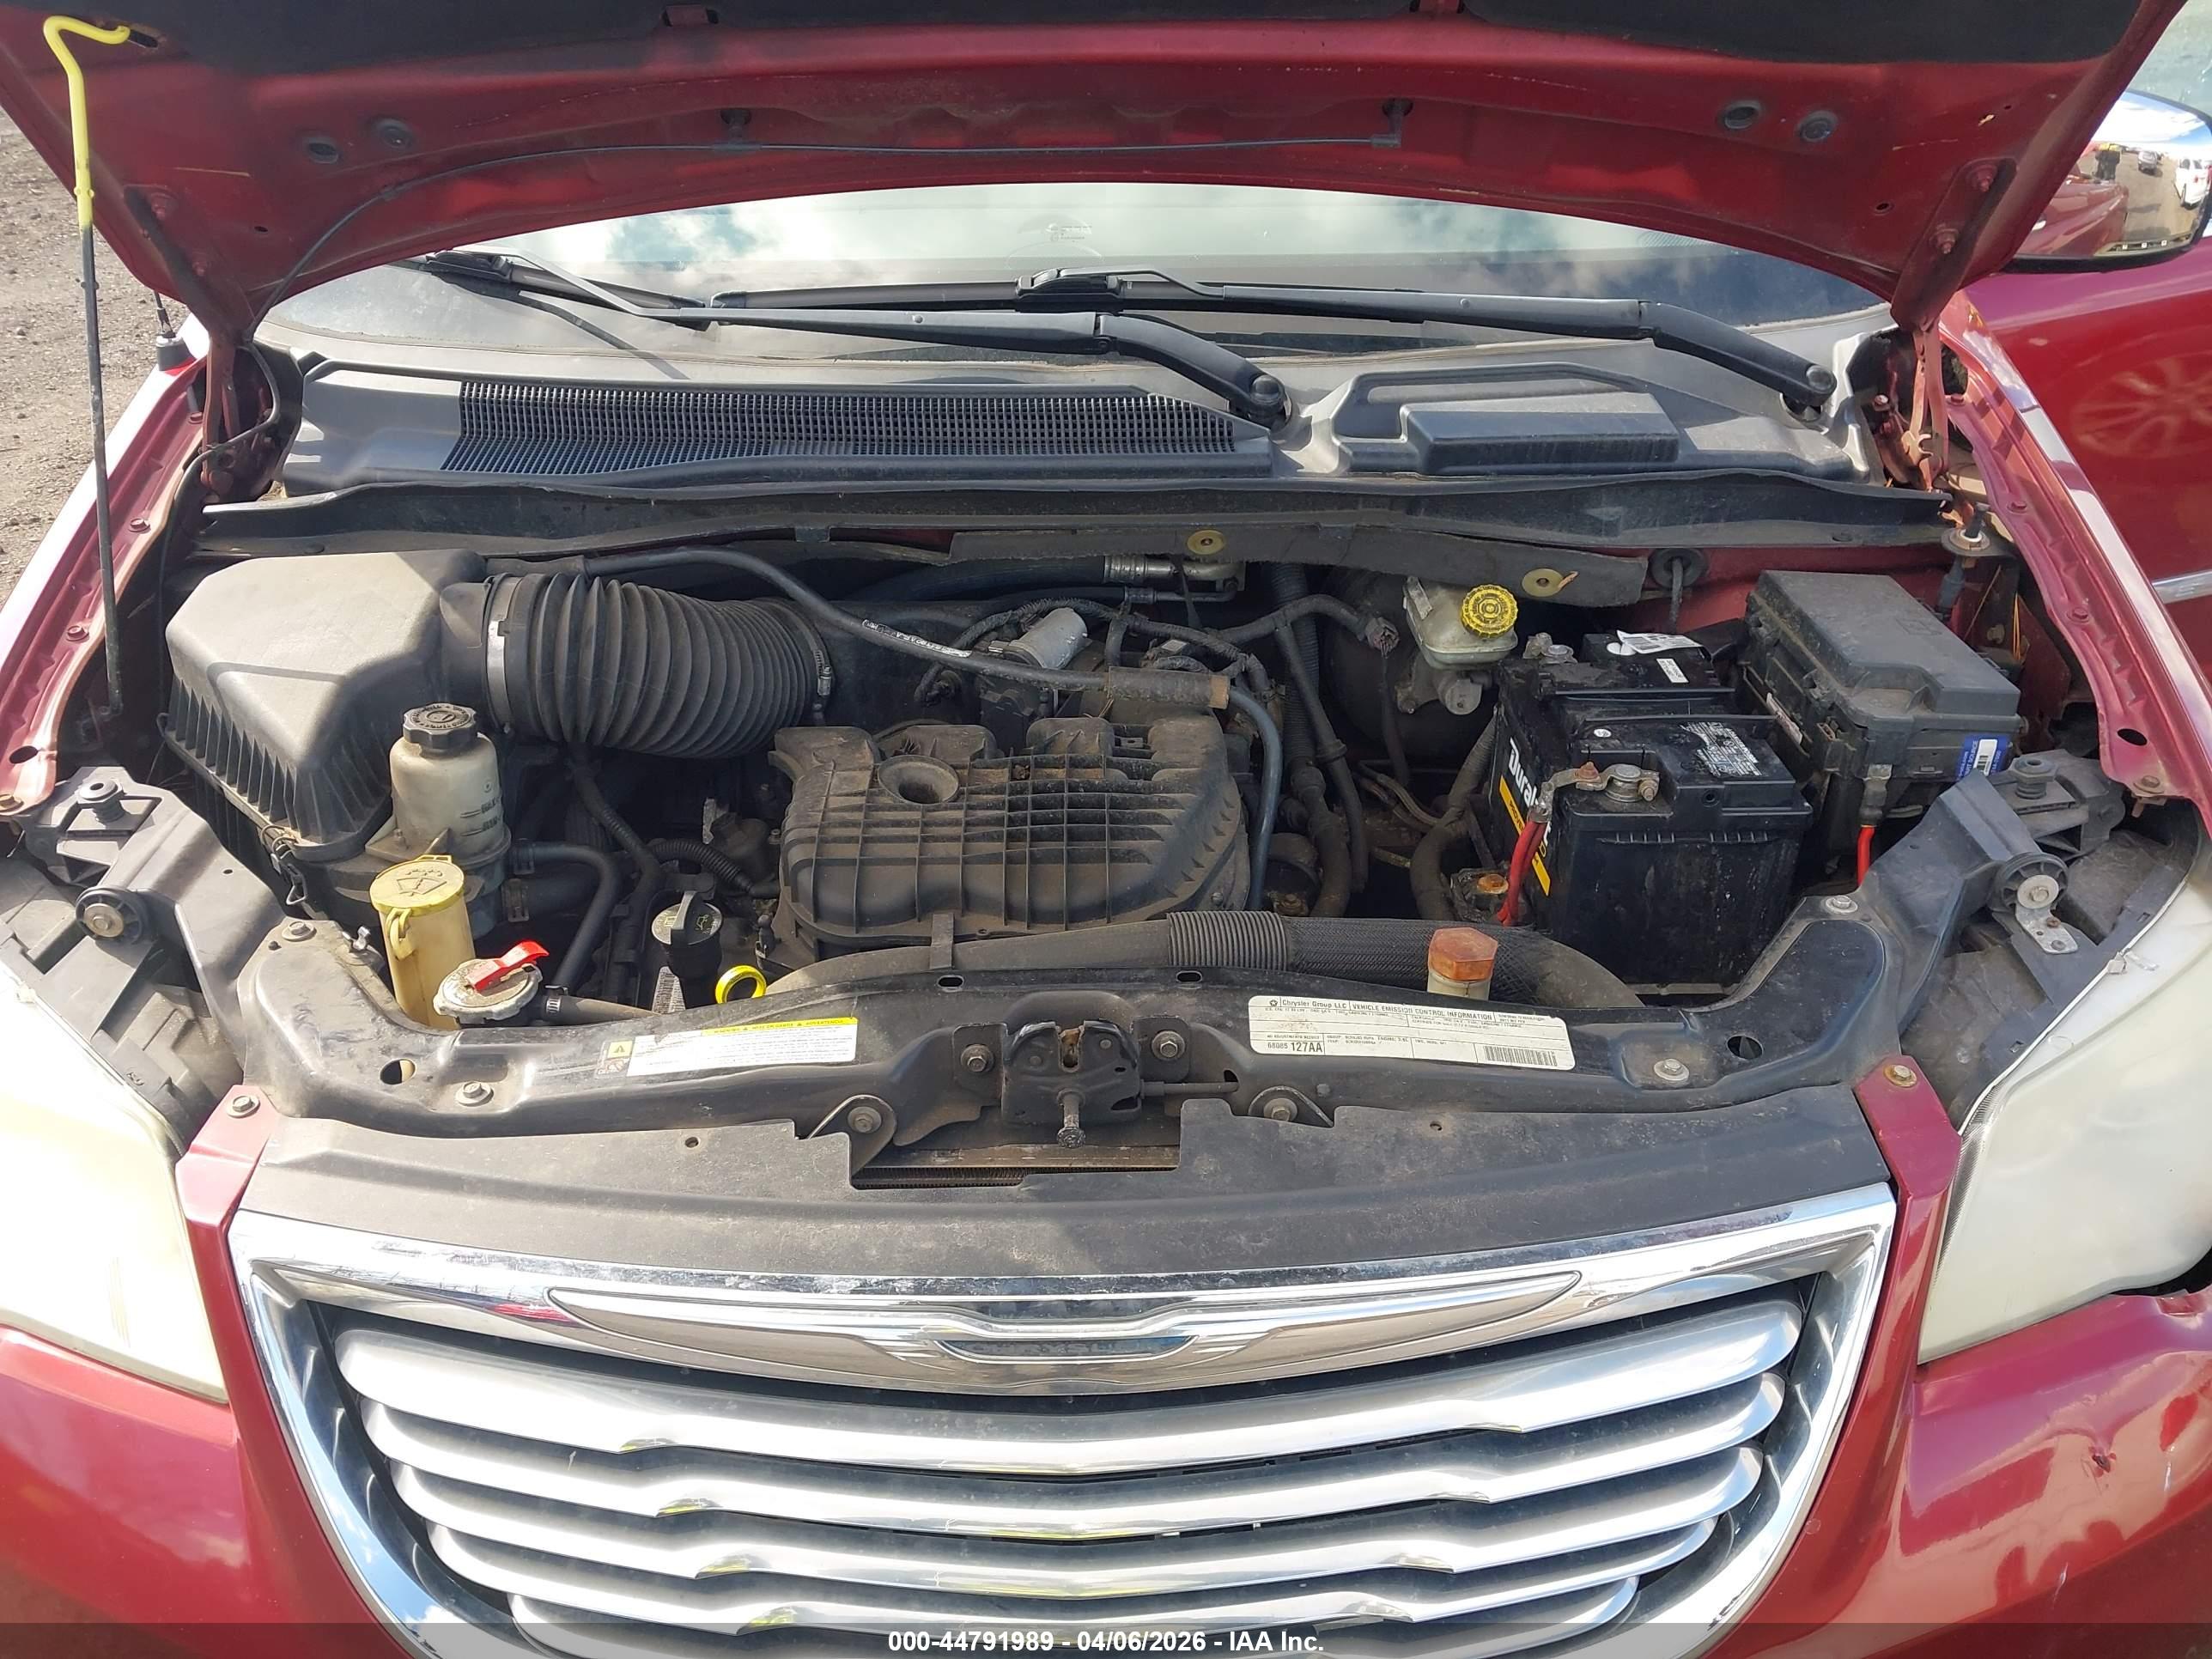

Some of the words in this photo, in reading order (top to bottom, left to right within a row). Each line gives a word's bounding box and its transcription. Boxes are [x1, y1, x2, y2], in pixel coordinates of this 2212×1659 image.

[1282, 999, 1310, 1008] Chrysler
[1352, 1003, 1379, 1012] VEHICLE
[1381, 1006, 1413, 1015] EMISSION
[1415, 1008, 1446, 1017] CONTROL
[1447, 1011, 1492, 1021] INFORMATION
[1291, 1042, 1322, 1053] 127AA
